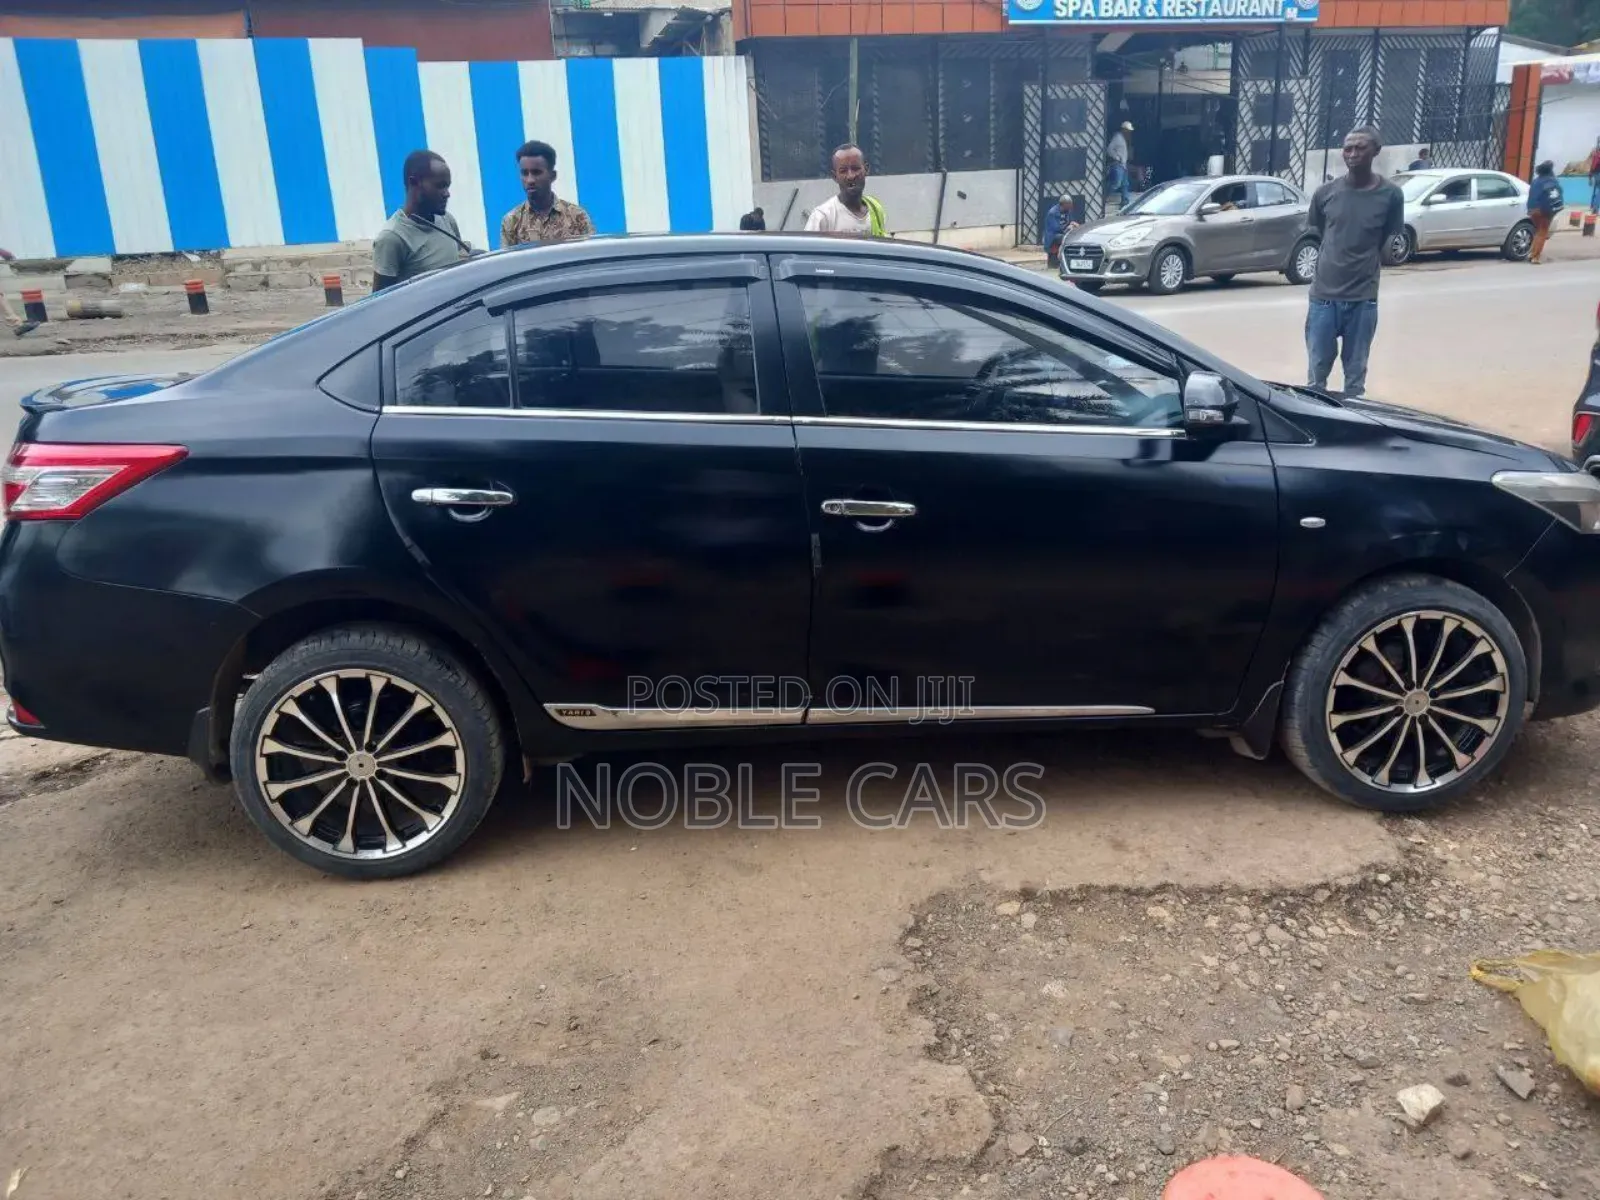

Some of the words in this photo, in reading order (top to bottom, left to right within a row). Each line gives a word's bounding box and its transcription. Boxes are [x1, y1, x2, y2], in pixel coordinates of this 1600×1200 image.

[1054, 0, 1096, 18] SPA
[1100, 0, 1141, 18] BAR
[1144, 0, 1160, 17] &
[1161, 0, 1284, 18] RESTAURANT
